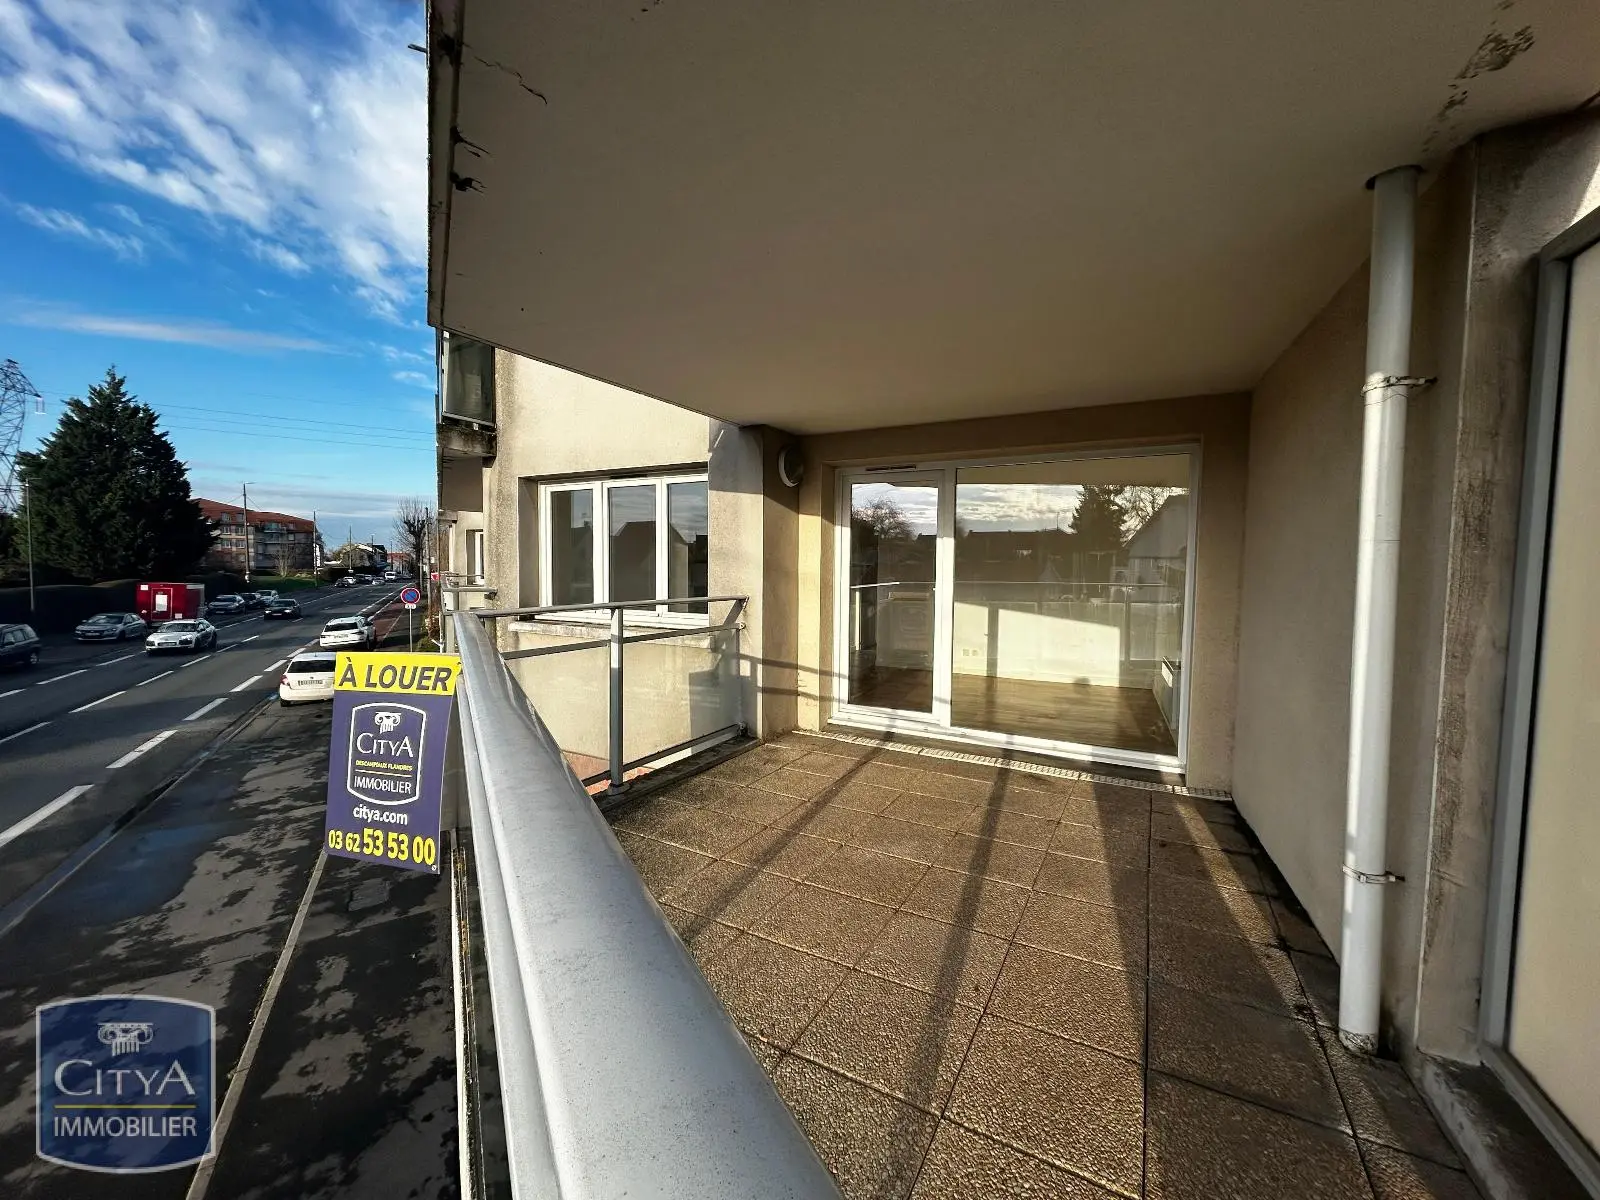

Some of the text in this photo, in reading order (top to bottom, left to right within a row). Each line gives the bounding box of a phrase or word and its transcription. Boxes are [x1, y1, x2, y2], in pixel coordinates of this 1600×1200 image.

[339, 657, 451, 691] À LOUER
[354, 775, 412, 794] IMMOBILIER
[353, 804, 408, 825] citya.com
[328, 828, 436, 865] 03 62 53 53 00
